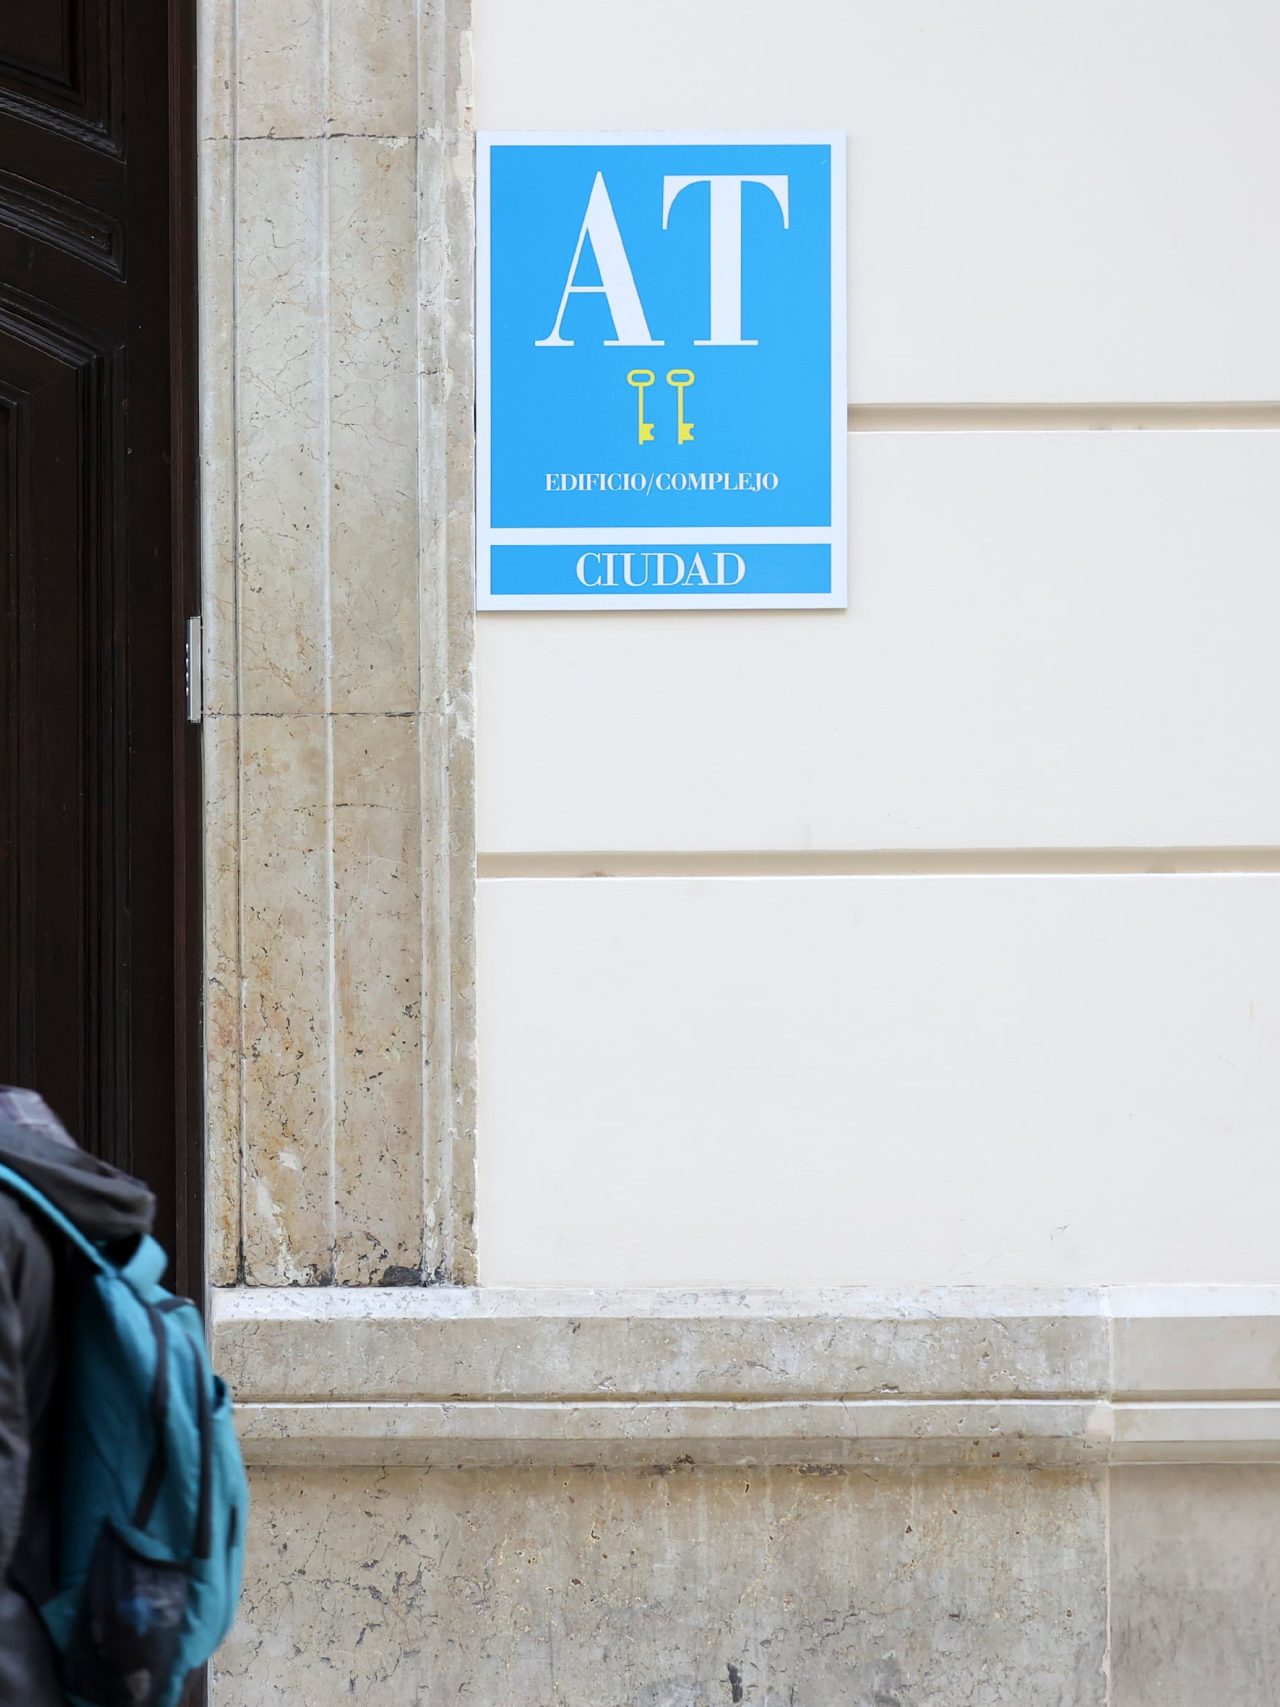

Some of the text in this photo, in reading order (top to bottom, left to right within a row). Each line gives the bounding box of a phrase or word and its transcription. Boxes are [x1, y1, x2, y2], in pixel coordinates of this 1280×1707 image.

[534, 171, 790, 347] AT
[544, 472, 780, 496] EDIFICIO/COMPLEJO
[575, 551, 747, 588] CIUDAD
